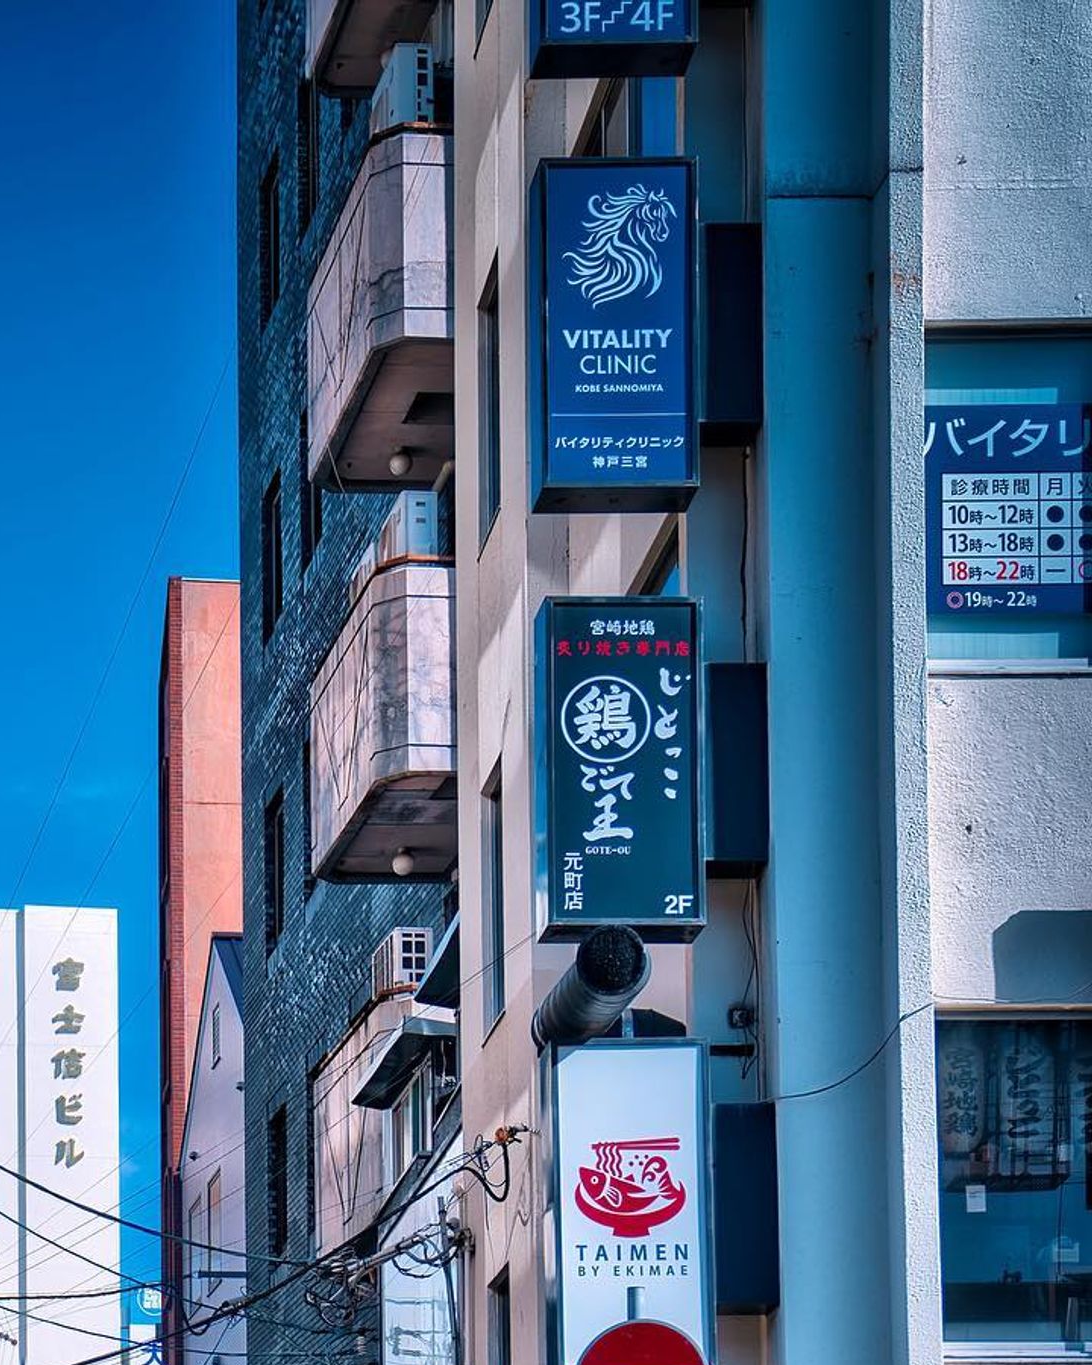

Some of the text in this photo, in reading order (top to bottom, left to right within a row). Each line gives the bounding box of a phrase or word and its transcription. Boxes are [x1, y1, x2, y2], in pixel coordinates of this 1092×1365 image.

[561, 0, 675, 33] 3F 4F
[562, 328, 673, 350] VITALITY
[580, 355, 656, 375] CLINIC
[575, 384, 663, 393] KOBE SANNOMIYA
[554, 435, 684, 449] バイタリティクリニック
[592, 455, 648, 469] 神戸三宮
[951, 478, 1030, 496] 診療時間
[1046, 478, 1063, 496] 月
[589, 619, 656, 636] 宮崎地鶏
[556, 640, 691, 657] 炙り焼き専門店
[585, 846, 632, 855] GOTE-OU
[563, 852, 584, 911] 元町店
[664, 895, 694, 915] 2F
[576, 1244, 689, 1262] TAIMEN
[578, 1264, 688, 1277] BY EKIMAE
